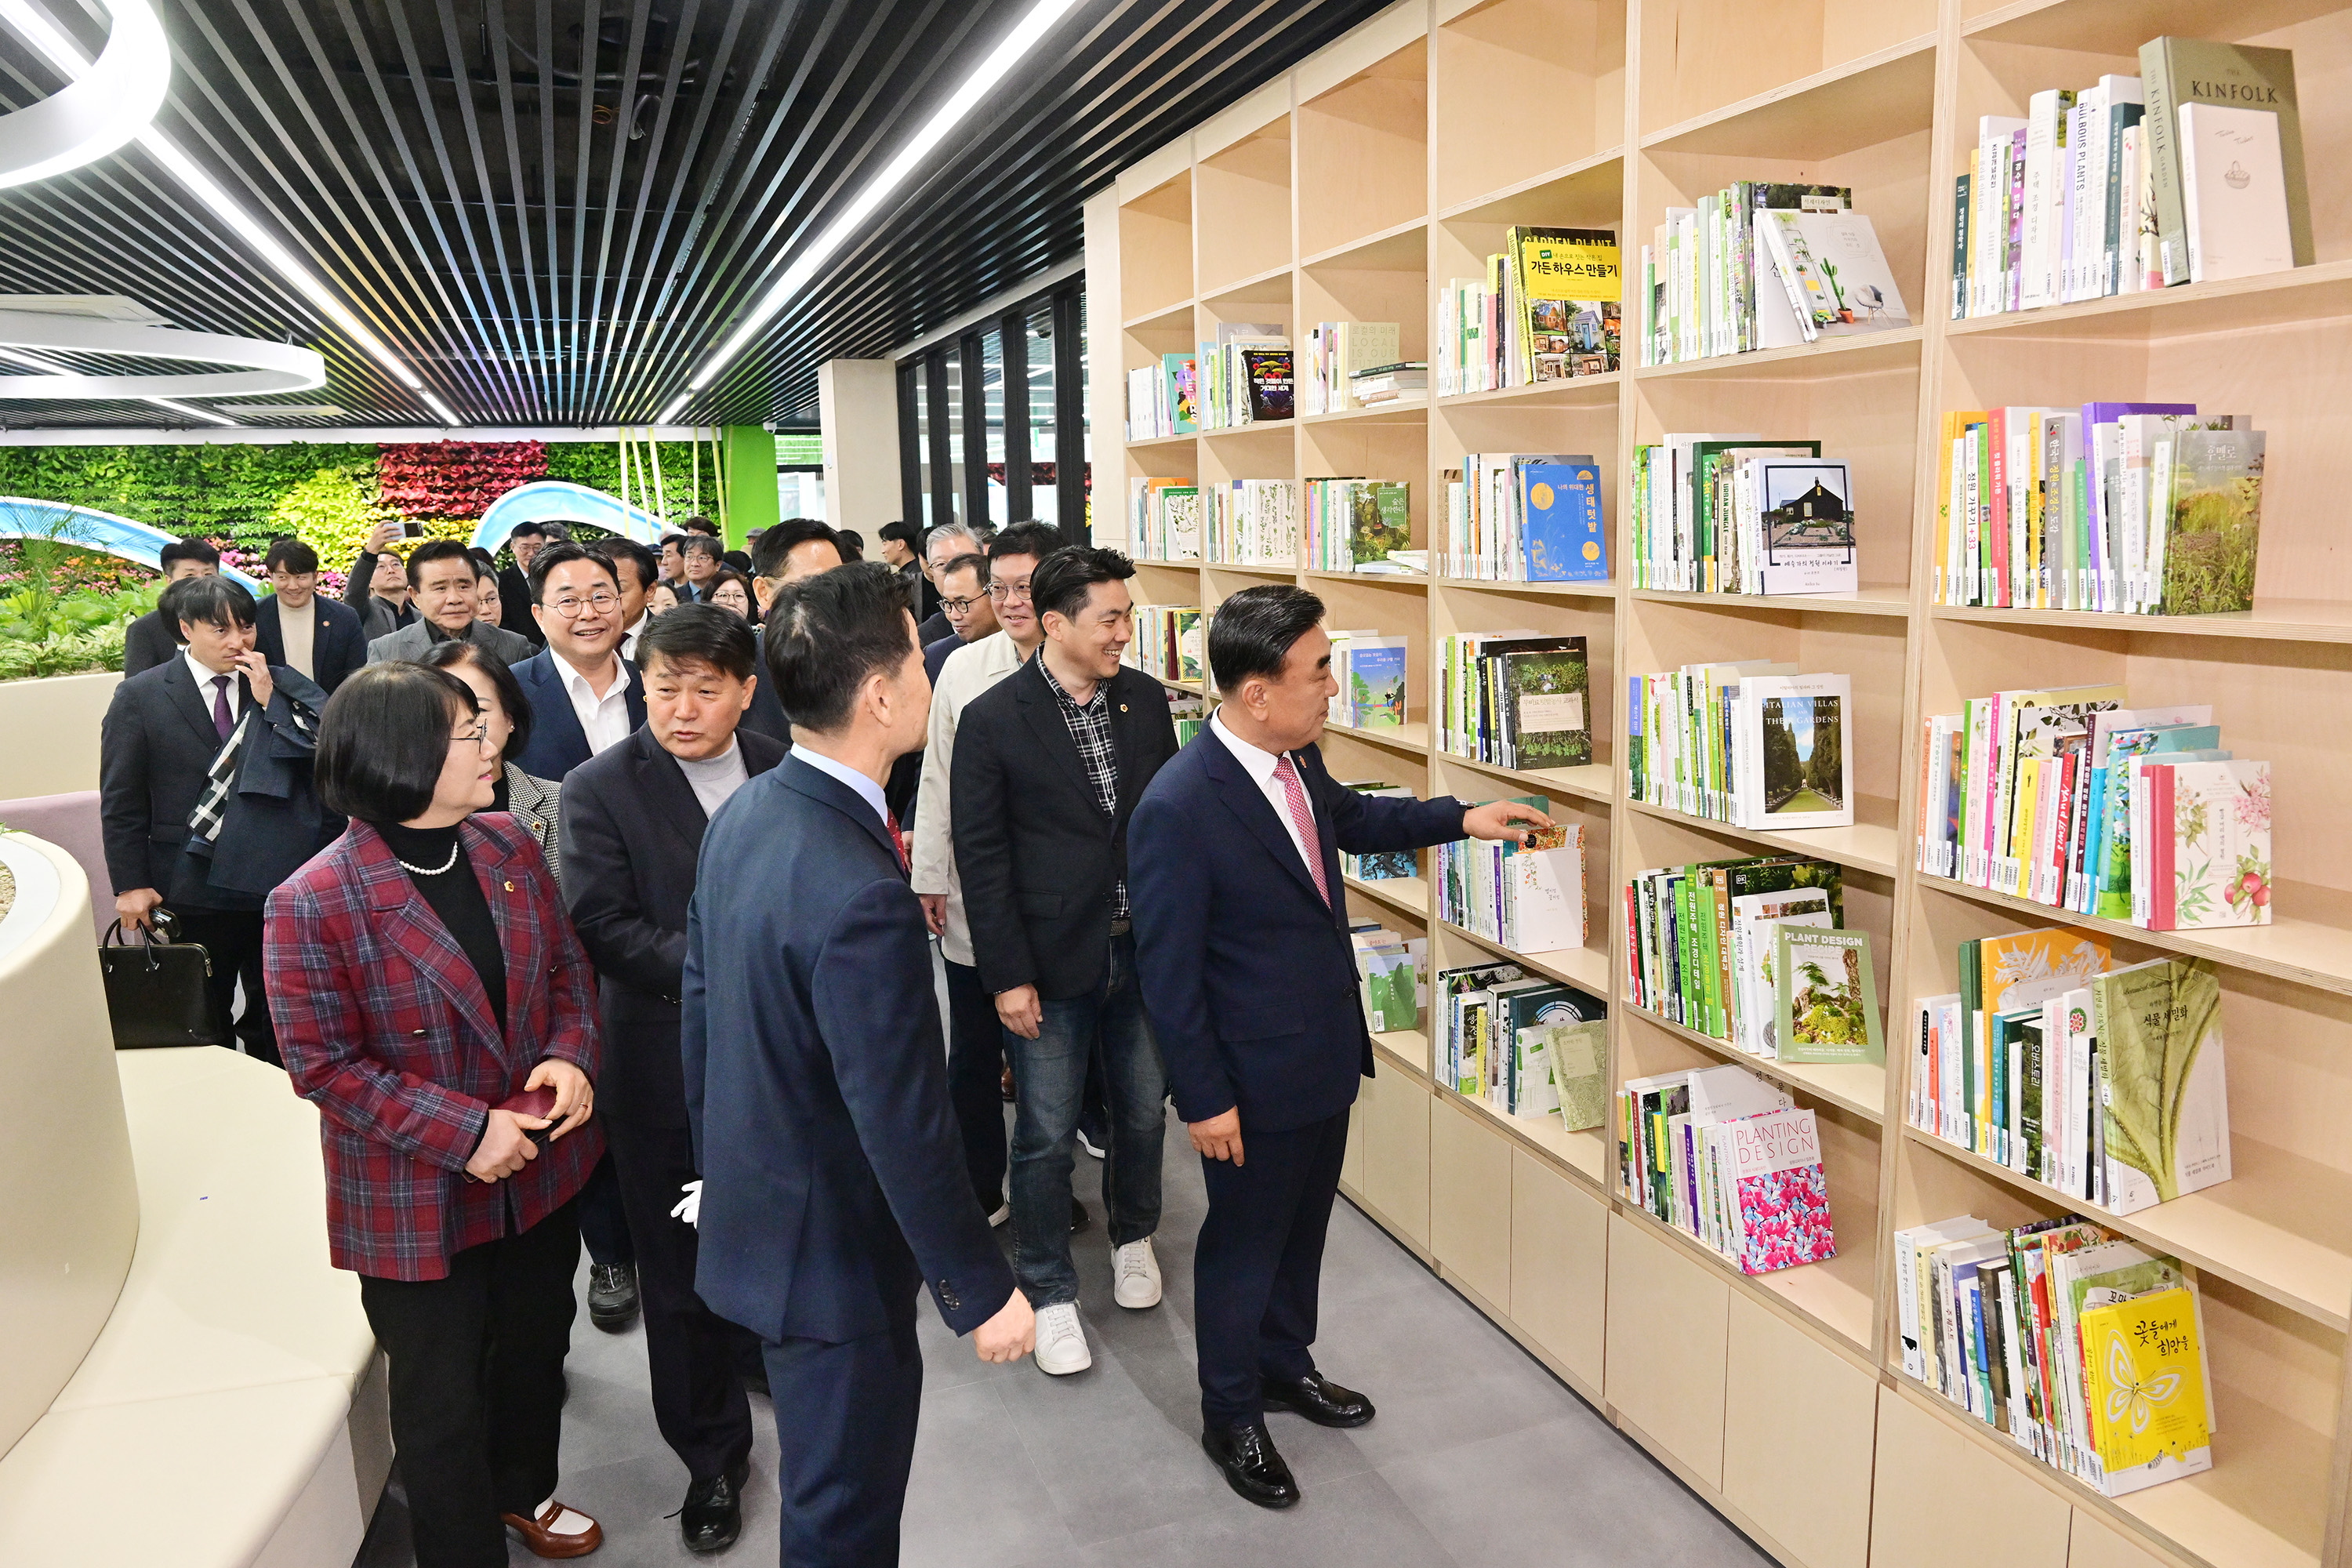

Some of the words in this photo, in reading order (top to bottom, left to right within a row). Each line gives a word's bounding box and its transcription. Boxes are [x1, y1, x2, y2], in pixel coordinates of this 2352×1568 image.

[2192, 80, 2278, 103] KINFOLK
[2078, 103, 2087, 149] BULBOUS
[2151, 88, 2166, 154] KINFOLK
[2013, 154, 2022, 189] 조경수에
[2033, 171, 2040, 189] 주택
[2076, 149, 2085, 191] PLANTS
[2032, 193, 2038, 212] 조경
[1531, 261, 1552, 274] 가든
[1552, 262, 1584, 276] 하우스
[1586, 264, 1617, 278] 만들기
[1508, 234, 1518, 261] GARDEN
[1515, 287, 1526, 342] COMBINATIONS
[1352, 326, 1376, 335] 로컬의
[1380, 326, 1396, 336] 미래
[1352, 338, 1396, 347] LOCAL
[1370, 349, 1396, 358] OUR
[2049, 439, 2059, 463] 한국의
[2205, 445, 2236, 461] 후멜로
[1968, 472, 1976, 491] 정원
[2130, 472, 2137, 487] 화초
[1392, 497, 1404, 506] 숲은
[2049, 516, 2059, 533] 도감
[1688, 891, 1697, 933] 전원주택
[1718, 903, 1726, 919] 정원
[1678, 913, 1686, 958] 전원주택
[1700, 913, 1708, 952] 전원주택
[1734, 918, 1744, 955] 정원계획과
[1784, 931, 1819, 942] PLANT
[1821, 935, 1863, 946] DESIGN
[1803, 943, 1842, 955] RECIPE
[1691, 938, 1700, 989] 조경디테일
[1737, 956, 1744, 972] 설계
[1681, 964, 1689, 986] 조경
[2143, 1014, 2161, 1027] 식물
[2162, 1005, 2188, 1022] 세밀화
[2100, 1041, 2107, 1054] 식물
[2031, 1043, 2041, 1087] 오버스토리
[1736, 1118, 1811, 1146] PLANTING
[1722, 1135, 1730, 1165] PLANTING
[1739, 1135, 1814, 1163] DESIGN
[2134, 1319, 2177, 1347] 꽃들에게
[2156, 1336, 2189, 1357] 희망을
